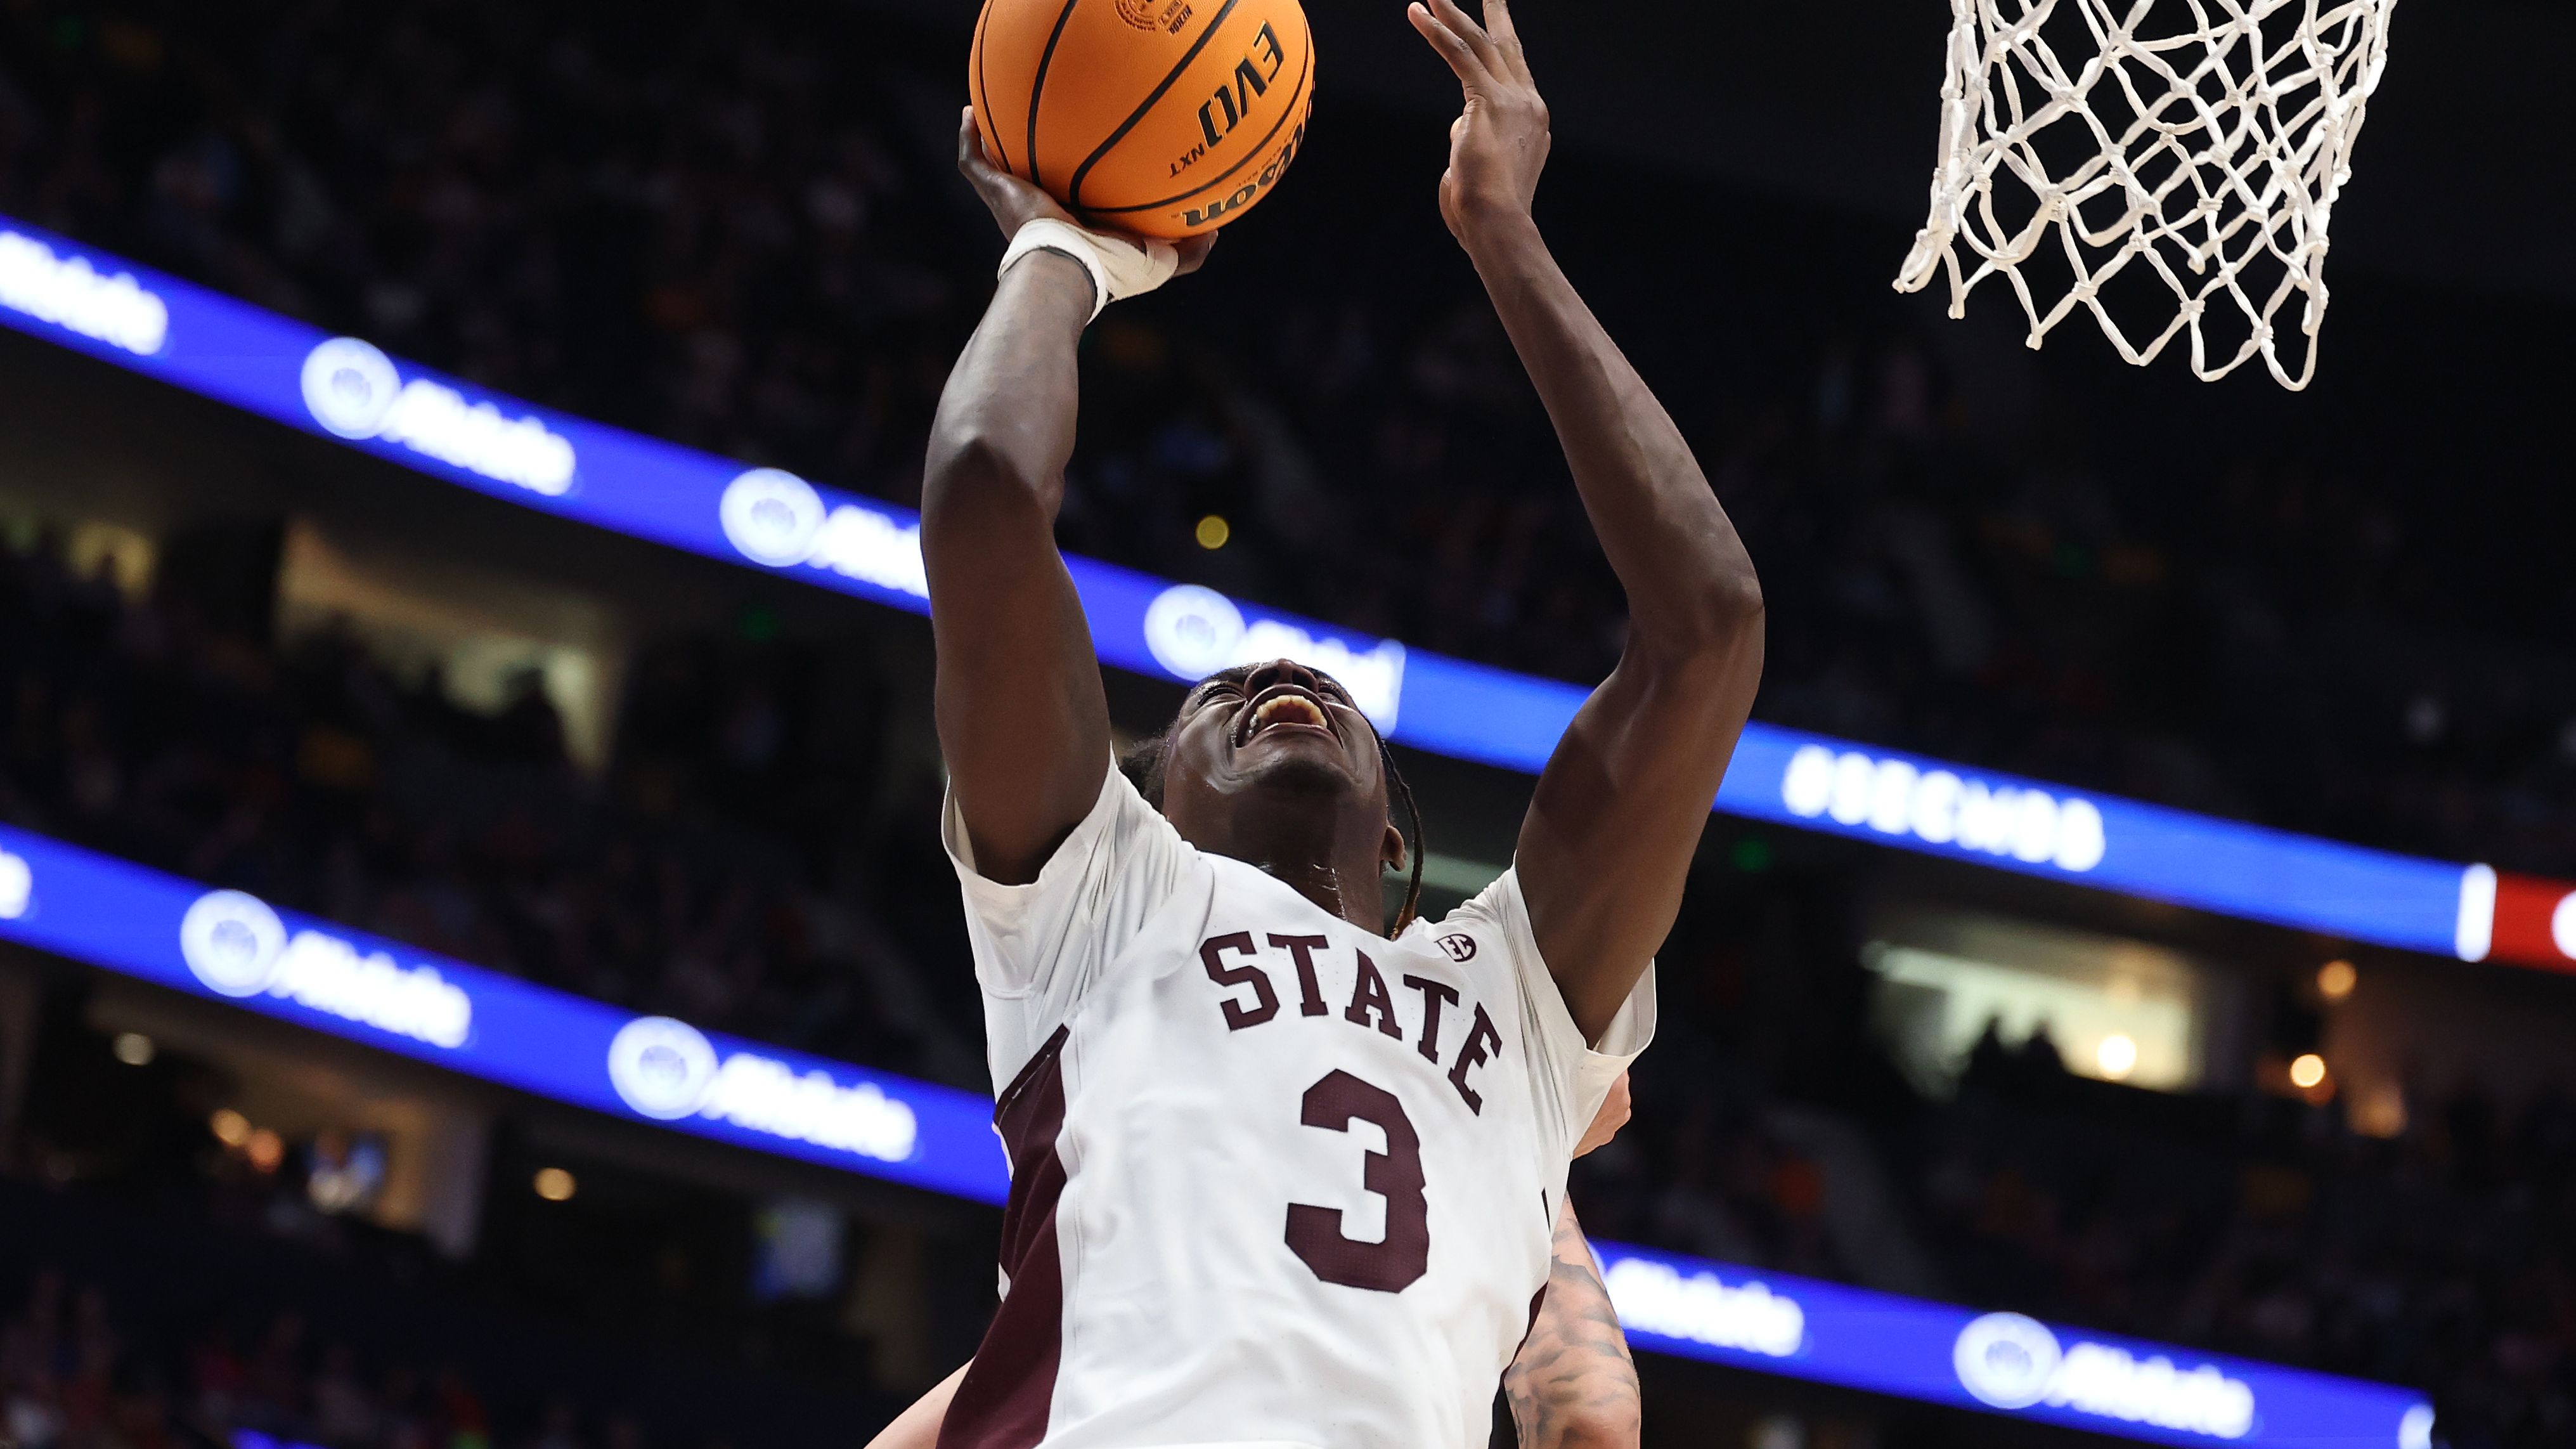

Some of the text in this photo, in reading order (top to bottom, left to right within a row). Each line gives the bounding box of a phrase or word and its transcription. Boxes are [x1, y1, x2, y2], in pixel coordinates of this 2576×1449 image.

[1168, 143, 1205, 178] NXT
[1198, 20, 1285, 149] EVO
[1198, 931, 1503, 1117] STATE
[1285, 1069, 1430, 1294] 3
